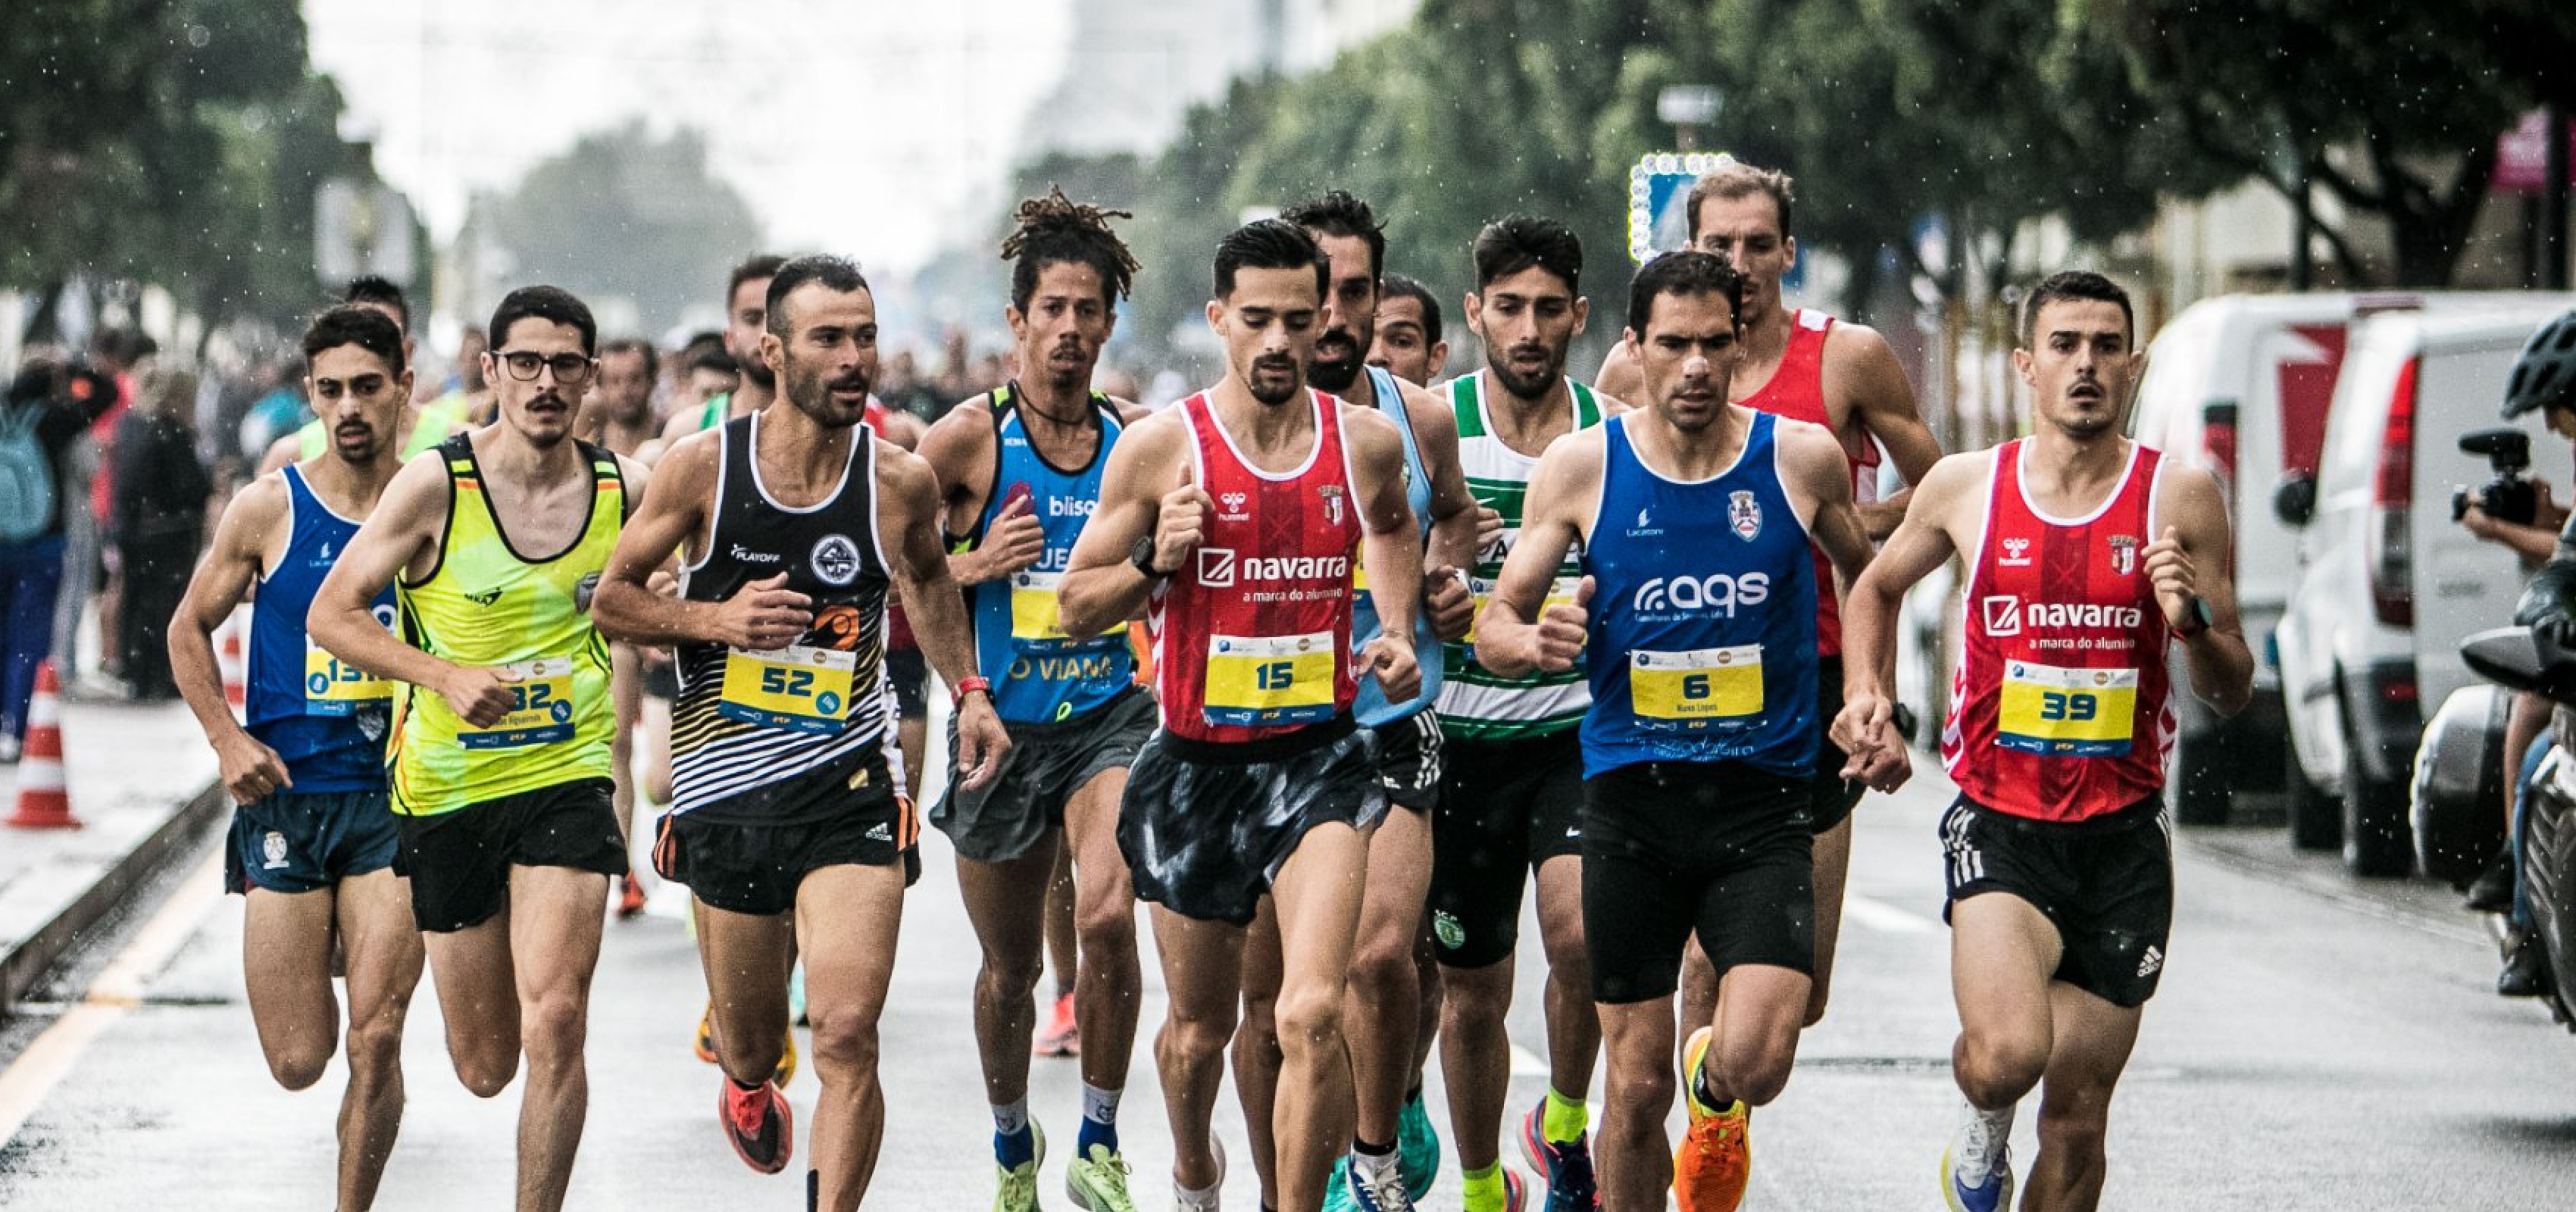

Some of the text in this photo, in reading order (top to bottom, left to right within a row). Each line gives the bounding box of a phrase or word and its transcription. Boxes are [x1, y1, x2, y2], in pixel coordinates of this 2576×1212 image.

[735, 551, 780, 563] PLAYOFF
[1243, 555, 1347, 580] navarra
[1243, 592, 1250, 602] a
[1253, 591, 1286, 602] marca
[1290, 588, 1303, 601] do
[2027, 603, 2143, 628] navarra
[2029, 638, 2037, 649] a
[2040, 638, 2074, 650] marca
[2077, 636, 2093, 649] do
[761, 667, 814, 698] 52
[1255, 661, 1294, 690] 15
[1682, 673, 1711, 700] 6
[2040, 691, 2097, 720] 39
